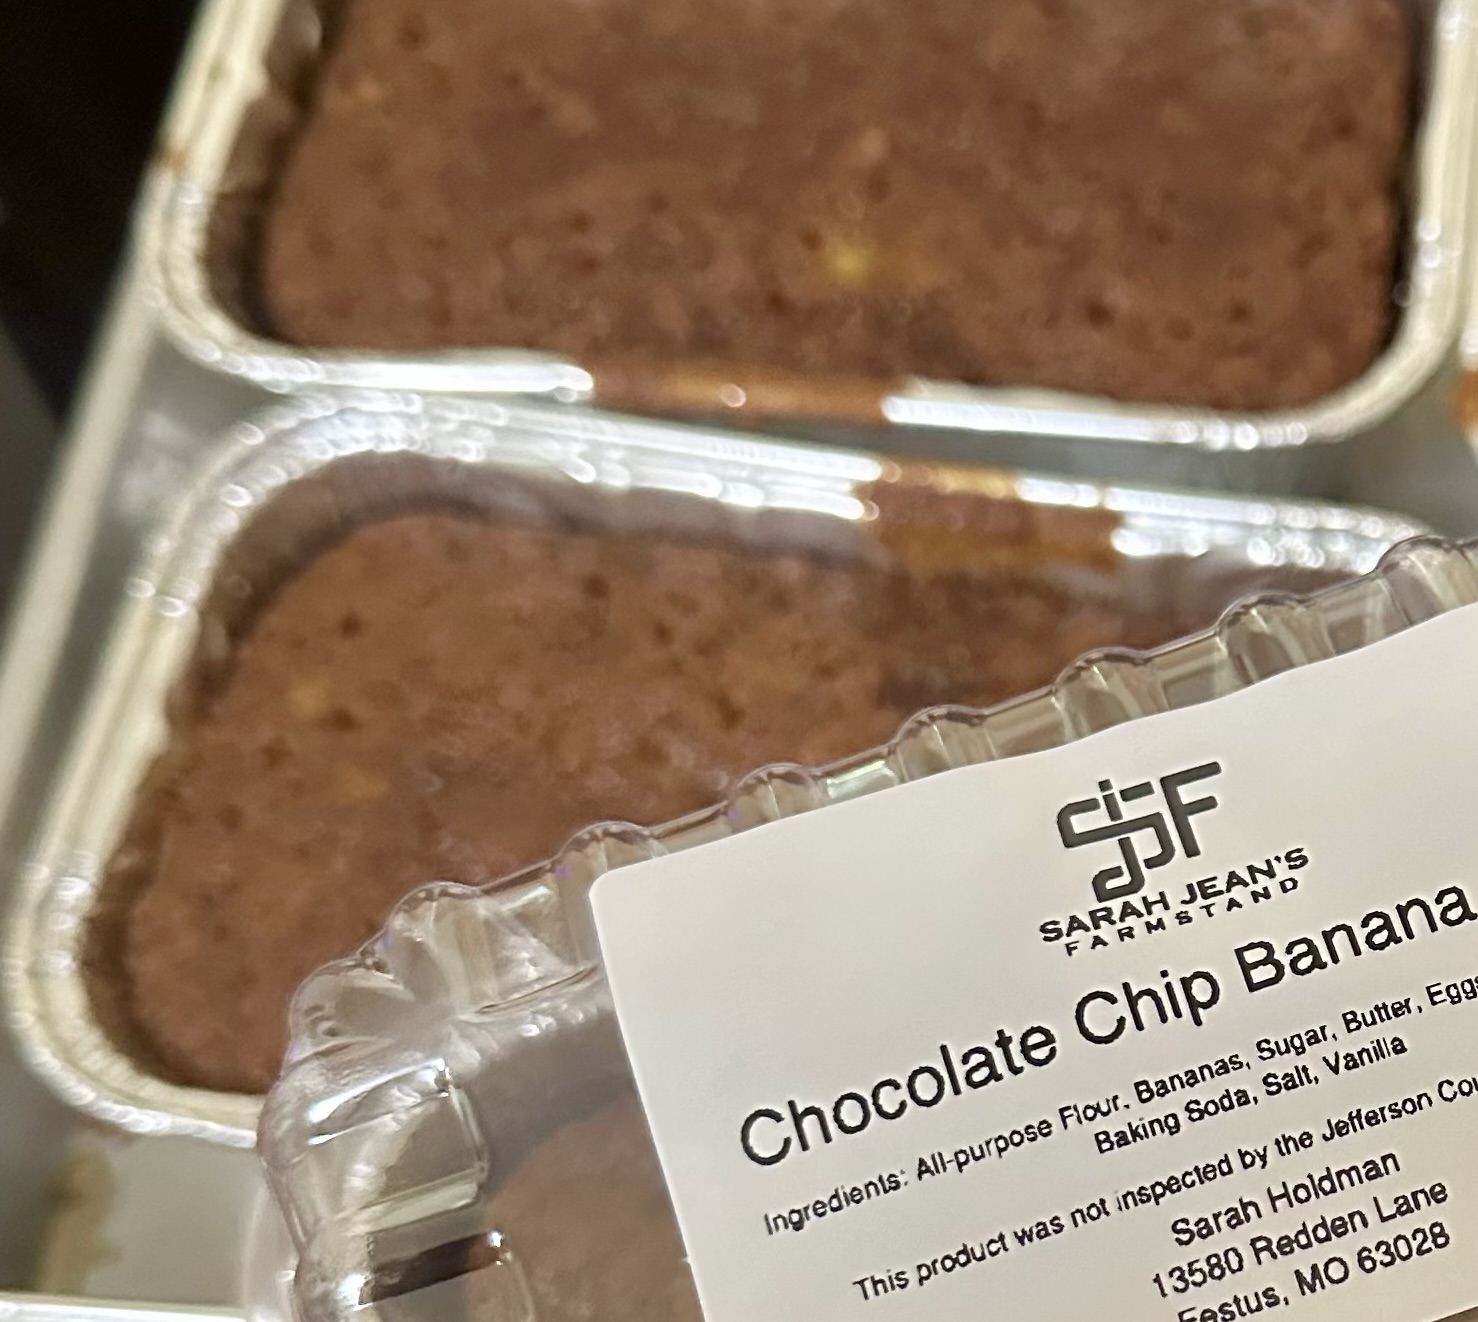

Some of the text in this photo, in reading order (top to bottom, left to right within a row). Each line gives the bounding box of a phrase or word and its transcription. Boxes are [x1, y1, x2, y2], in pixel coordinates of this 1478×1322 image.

[1039, 847, 1310, 943] SARAH JEAN'S
[1064, 877, 1299, 957] FARMSTAND
[740, 1025, 1057, 1167] Chocolate
[1075, 969, 1220, 1046] Chip
[1234, 886, 1478, 993] Banana
[763, 1168, 910, 1236] Ingredients:
[917, 1119, 1053, 1181] All-purpose
[1133, 1053, 1252, 1105] Bananas,
[1255, 1025, 1338, 1062] Sugar,
[1341, 997, 1423, 1034] Butter,
[1094, 1036, 1409, 1155] Baking Soda, Salt, Vanilla
[852, 1269, 910, 1301] This
[916, 1231, 1010, 1287] product
[1013, 1214, 1066, 1248] was
[1070, 1197, 1111, 1229] not
[1116, 1153, 1234, 1213] inspected
[1237, 1147, 1269, 1170] by
[1273, 1130, 1314, 1158] the
[1321, 1091, 1434, 1143] Jefferson
[1152, 1182, 1449, 1299] 13580 Redden Lane
[1170, 1152, 1401, 1247] Sarah Holdman
[1293, 1256, 1350, 1297] MO
[1356, 1220, 1451, 1275] 63028
